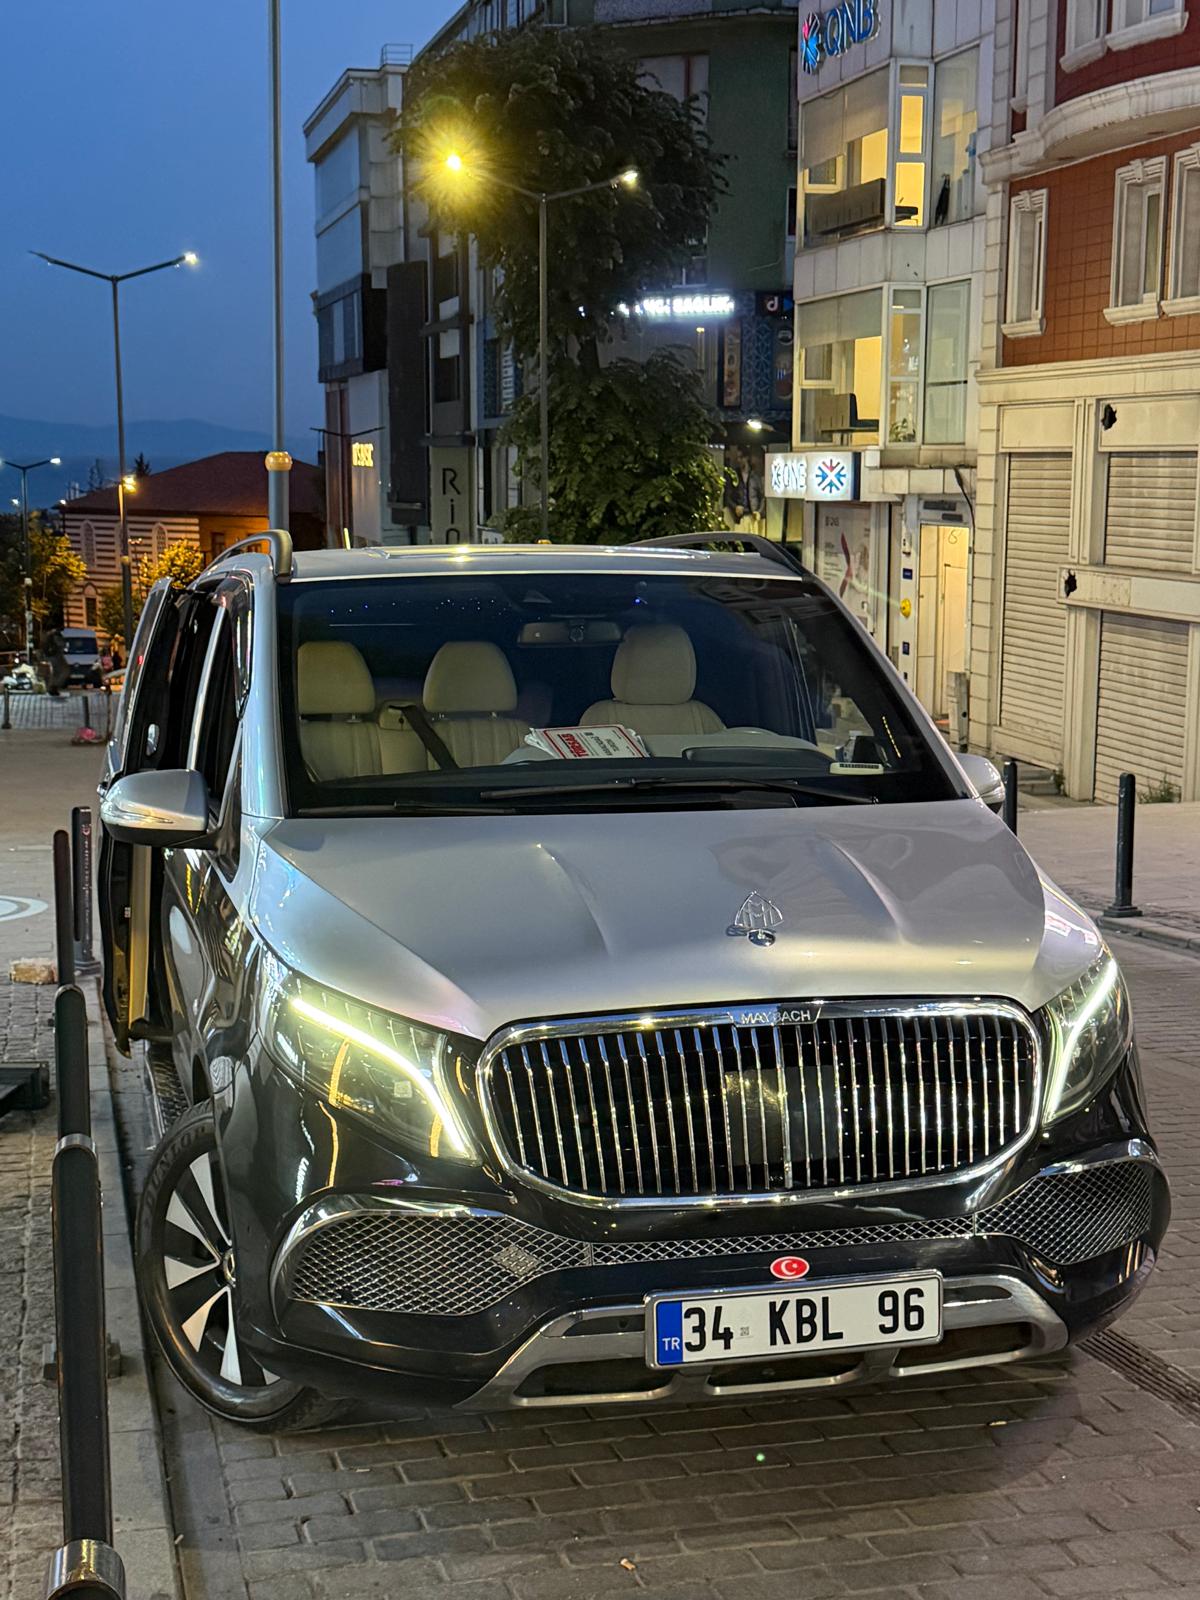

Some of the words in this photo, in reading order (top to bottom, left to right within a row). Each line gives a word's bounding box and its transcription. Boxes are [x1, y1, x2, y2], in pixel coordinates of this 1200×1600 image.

[824, 0, 876, 56] QNB
[740, 1009, 811, 1025] MAYBACH
[683, 1306, 734, 1352] 34
[768, 1296, 844, 1347] KBL
[877, 1287, 925, 1334] 96
[662, 1337, 680, 1351] TR
